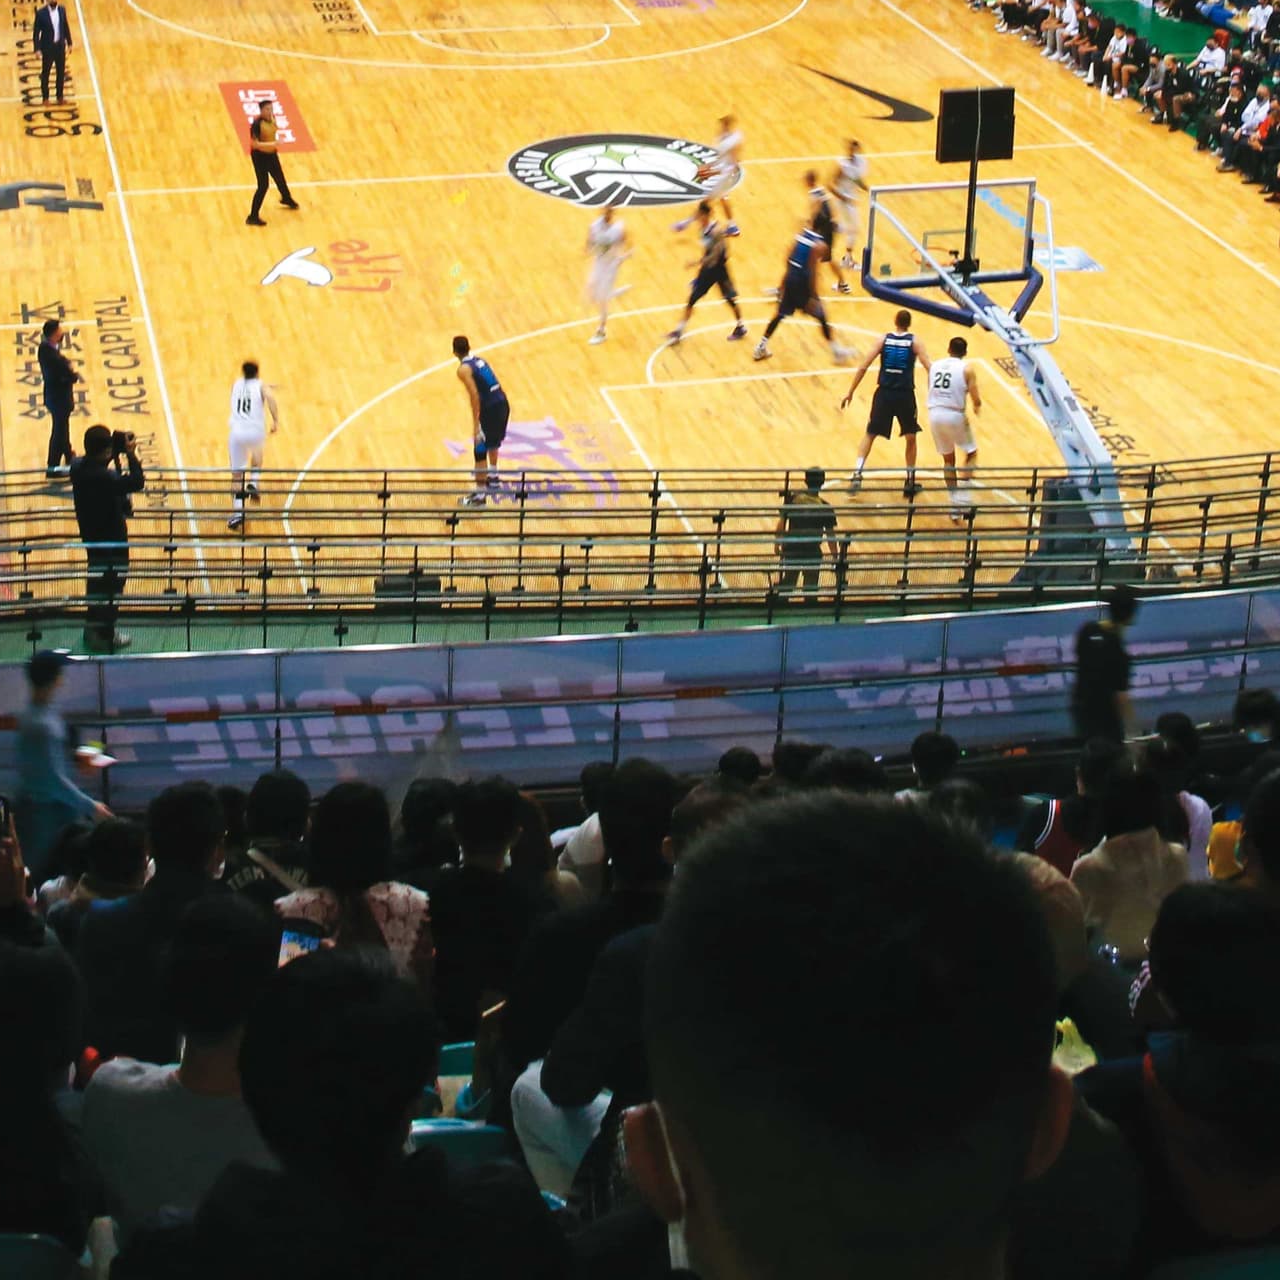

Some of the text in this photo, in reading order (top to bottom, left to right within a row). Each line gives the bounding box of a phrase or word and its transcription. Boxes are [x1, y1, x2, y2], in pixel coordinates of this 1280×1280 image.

[94, 295, 151, 416] ACE CAPITAL
[933, 372, 953, 389] 26
